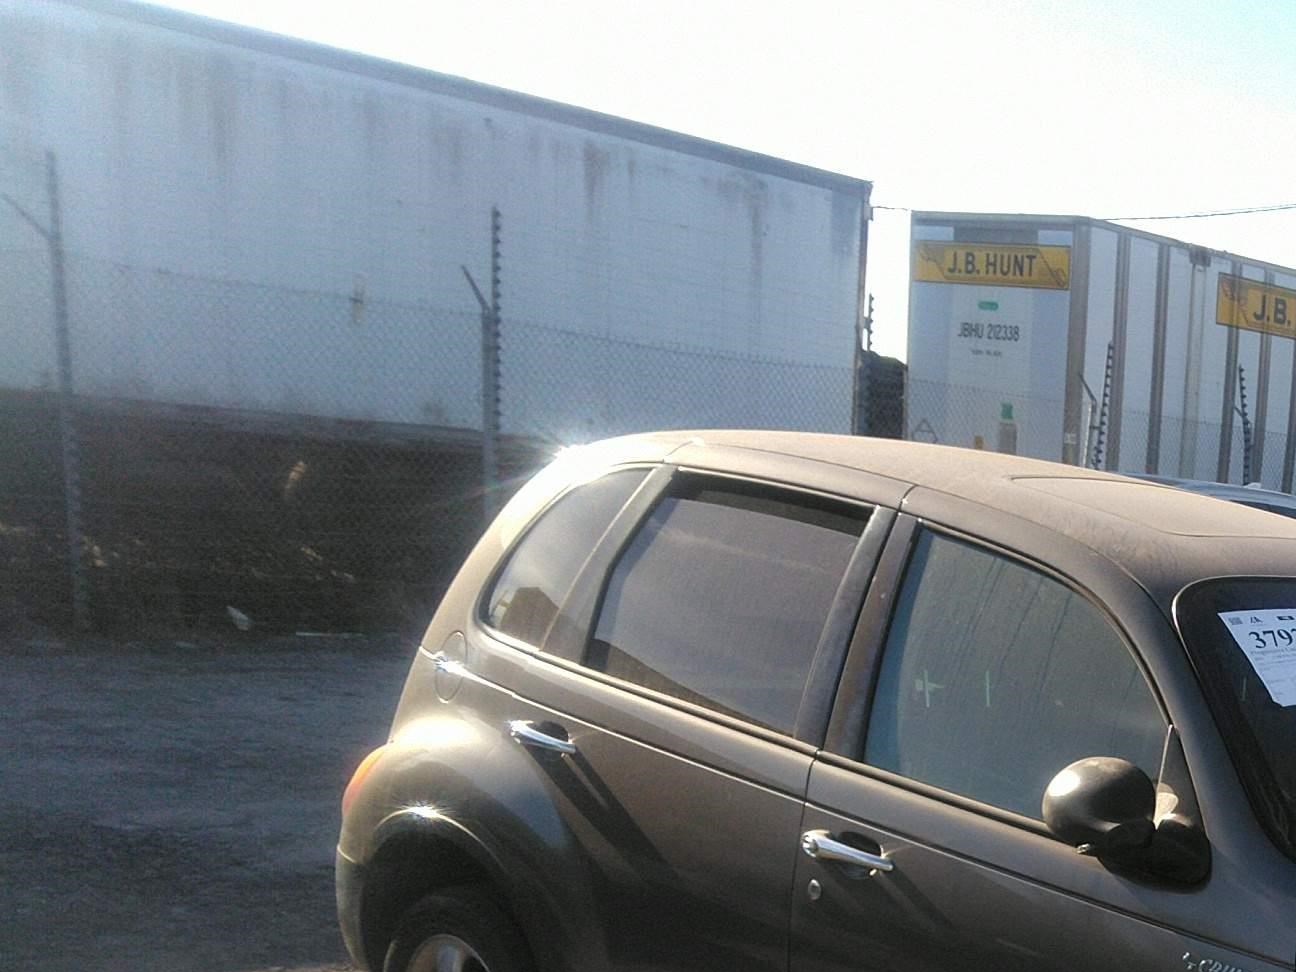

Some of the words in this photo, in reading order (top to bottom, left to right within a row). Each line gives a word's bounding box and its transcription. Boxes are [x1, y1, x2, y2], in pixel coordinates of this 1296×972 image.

[947, 250, 980, 275] J.B.
[985, 252, 1037, 278] HUNT
[1253, 294, 1291, 327] J.B.
